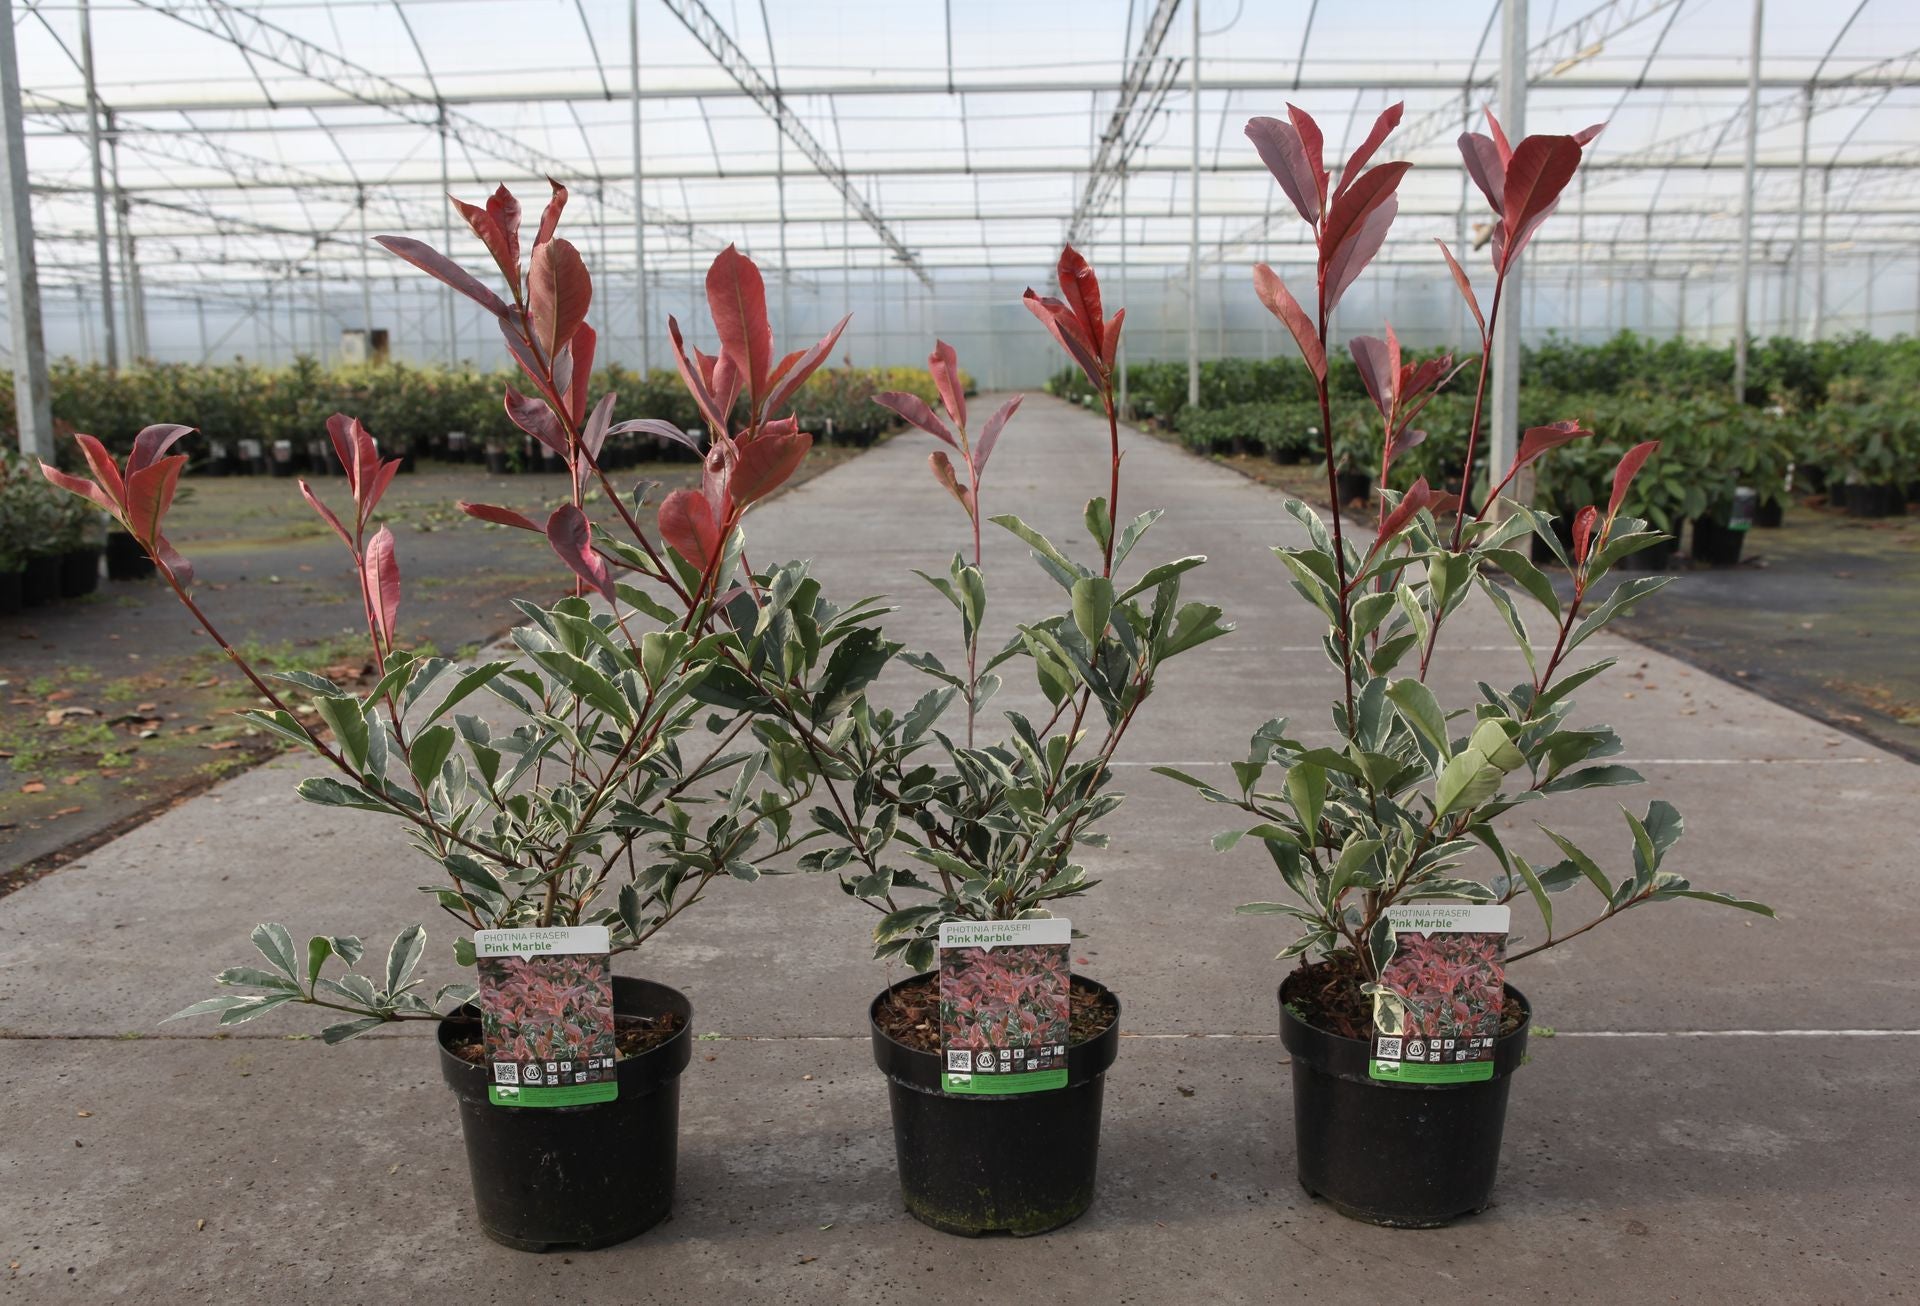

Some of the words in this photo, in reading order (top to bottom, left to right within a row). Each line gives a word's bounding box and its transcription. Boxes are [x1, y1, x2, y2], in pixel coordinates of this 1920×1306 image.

[1389, 909, 1431, 918] PHOTINIA
[1432, 909, 1471, 918] FRASERI
[946, 924, 990, 934] PHOTINIA
[991, 923, 1031, 932] FRASERI
[1389, 918, 1412, 928] Pink
[1414, 918, 1453, 928] Marble
[483, 932, 528, 942] PHOTINIA
[529, 931, 570, 940] FRASERI
[946, 933, 971, 944] Pink
[974, 933, 1013, 943] Marble
[484, 942, 510, 953] Pink
[512, 941, 552, 952] Marble
